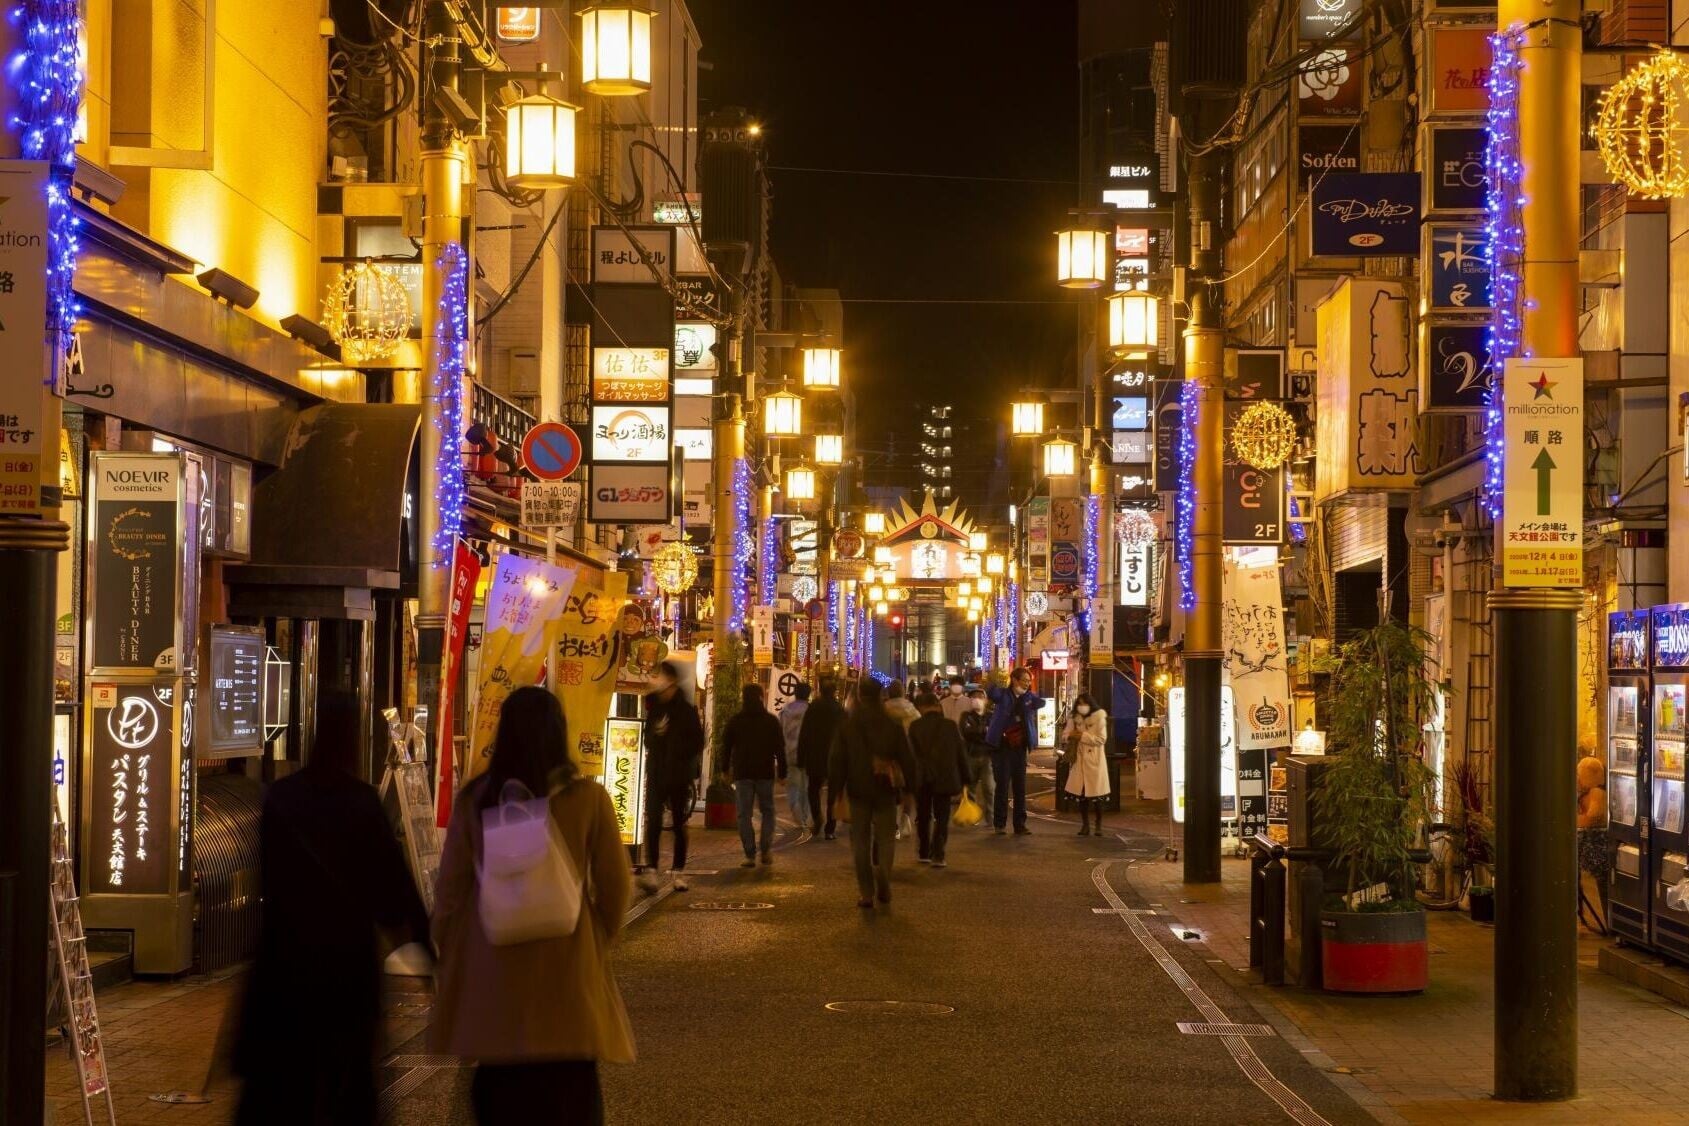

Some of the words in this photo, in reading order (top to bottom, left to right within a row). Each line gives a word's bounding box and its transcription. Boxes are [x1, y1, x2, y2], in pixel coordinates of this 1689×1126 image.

[1302, 152, 1357, 168] Soften
[1508, 404, 1579, 415] millionation
[106, 470, 169, 483] NOEVIR
[113, 484, 163, 493] cosmetics
[1255, 524, 1277, 537] 2F
[1519, 522, 1567, 531] メイン会場は
[1509, 531, 1578, 541] 天文館公園です
[131, 566, 141, 616] BEAUTY
[131, 619, 141, 661] DINER
[59, 652, 70, 661] 2F
[160, 655, 173, 664] 3F
[159, 689, 172, 699] 2F
